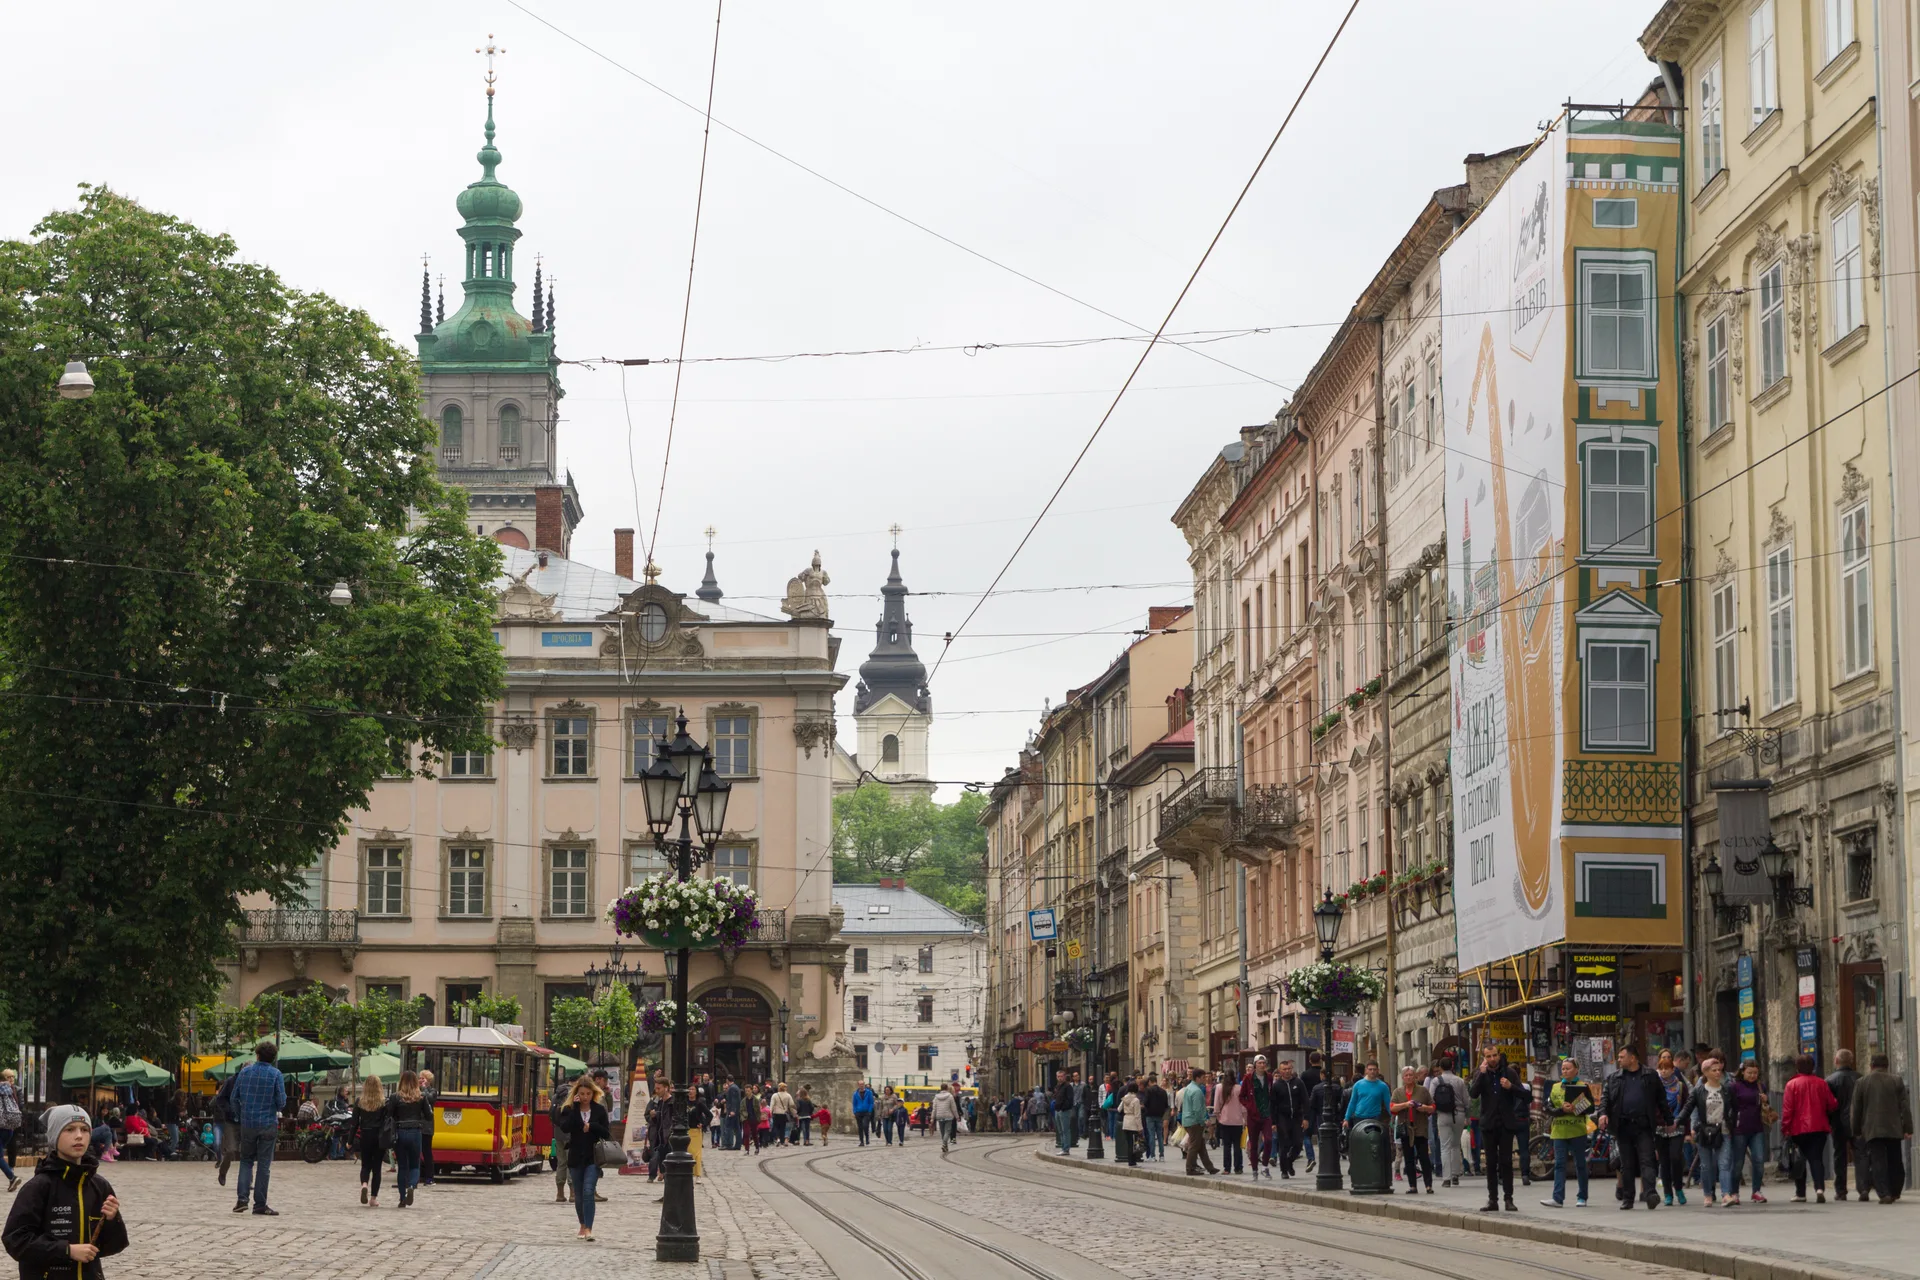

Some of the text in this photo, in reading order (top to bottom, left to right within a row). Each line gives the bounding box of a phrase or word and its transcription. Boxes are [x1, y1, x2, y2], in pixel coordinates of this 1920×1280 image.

[1514, 278, 1547, 335] ЛЬВІВ
[1465, 692, 1496, 789] ДЖАЗ
[1468, 775, 1501, 830] НОТКАМИ
[1470, 832, 1496, 887] ПРАГИ
[1573, 955, 1617, 963] EXCHANGE
[1575, 980, 1613, 989] ОБМІН
[1574, 993, 1616, 1003] ВАЛЮТ
[1573, 1014, 1617, 1022] EXCHANGE
[1337, 1020, 1344, 1030] 5
